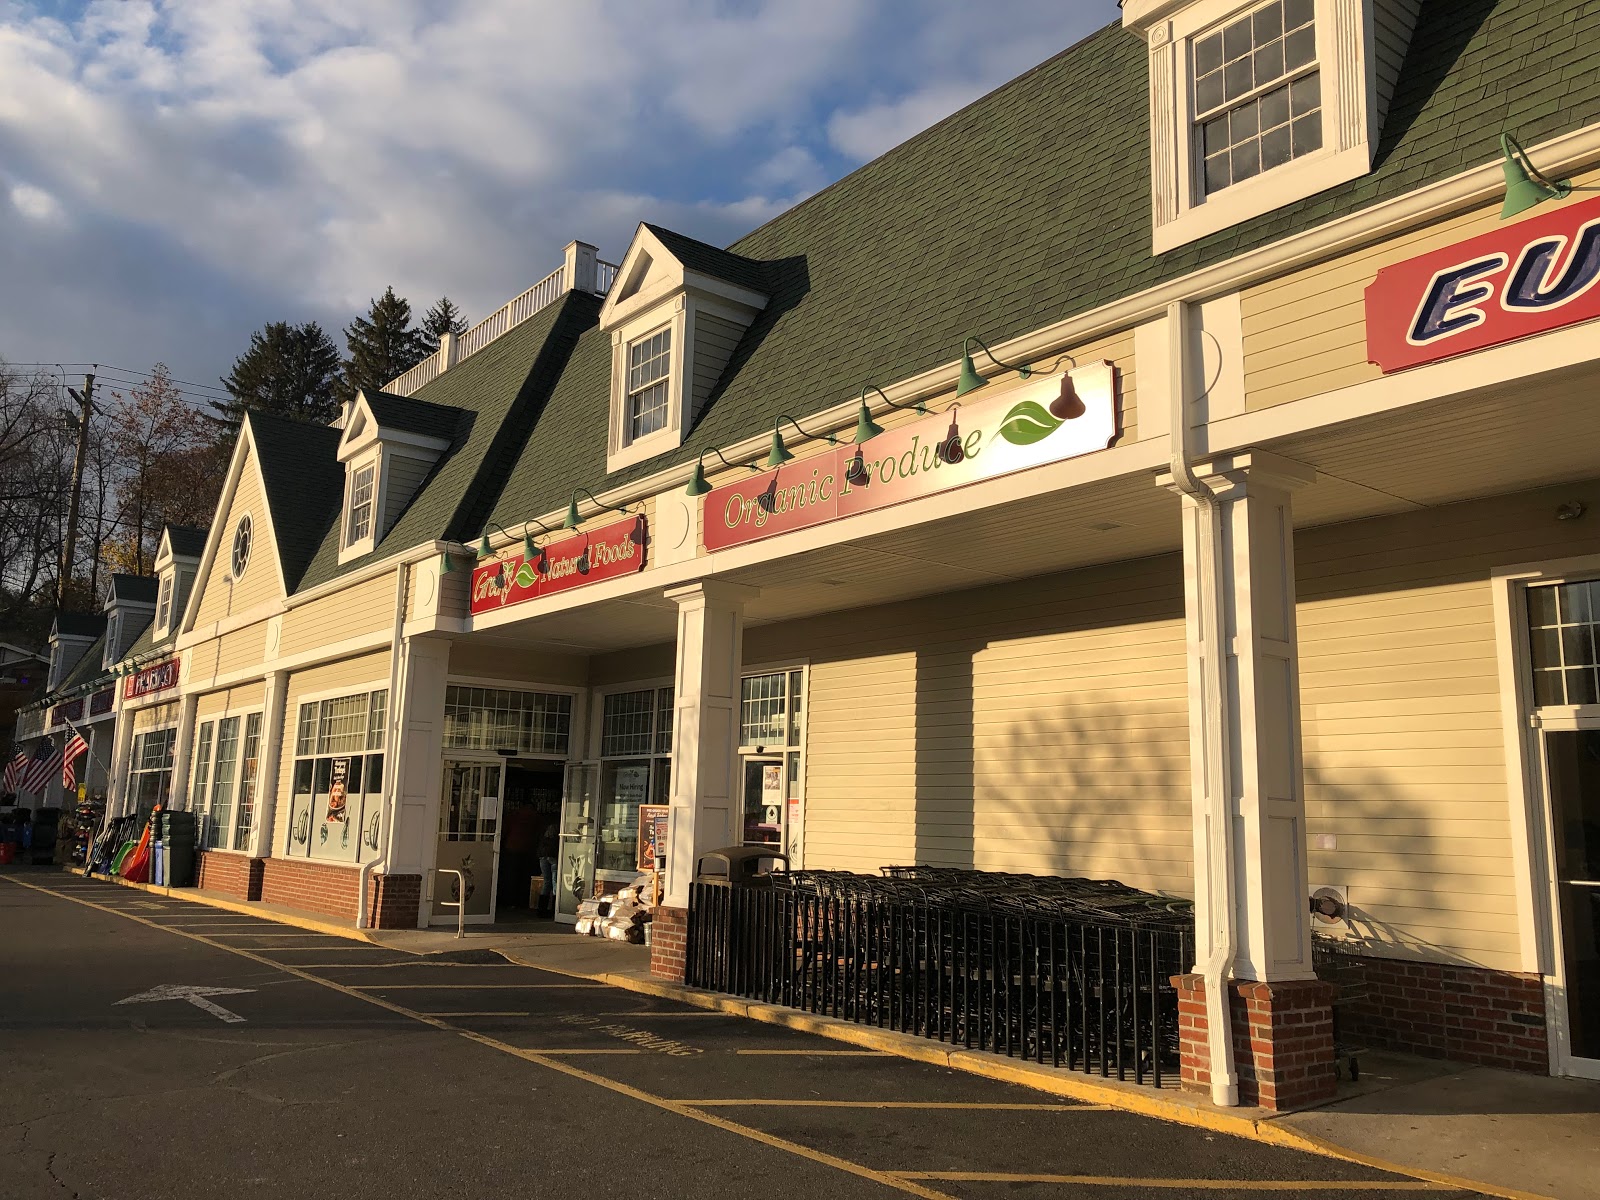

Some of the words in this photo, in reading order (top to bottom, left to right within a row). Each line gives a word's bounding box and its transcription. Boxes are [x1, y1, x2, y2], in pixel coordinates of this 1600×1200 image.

[724, 469, 834, 528] Organic
[839, 429, 982, 497] Produce
[540, 545, 592, 583] Natural
[593, 533, 635, 569] Foods
